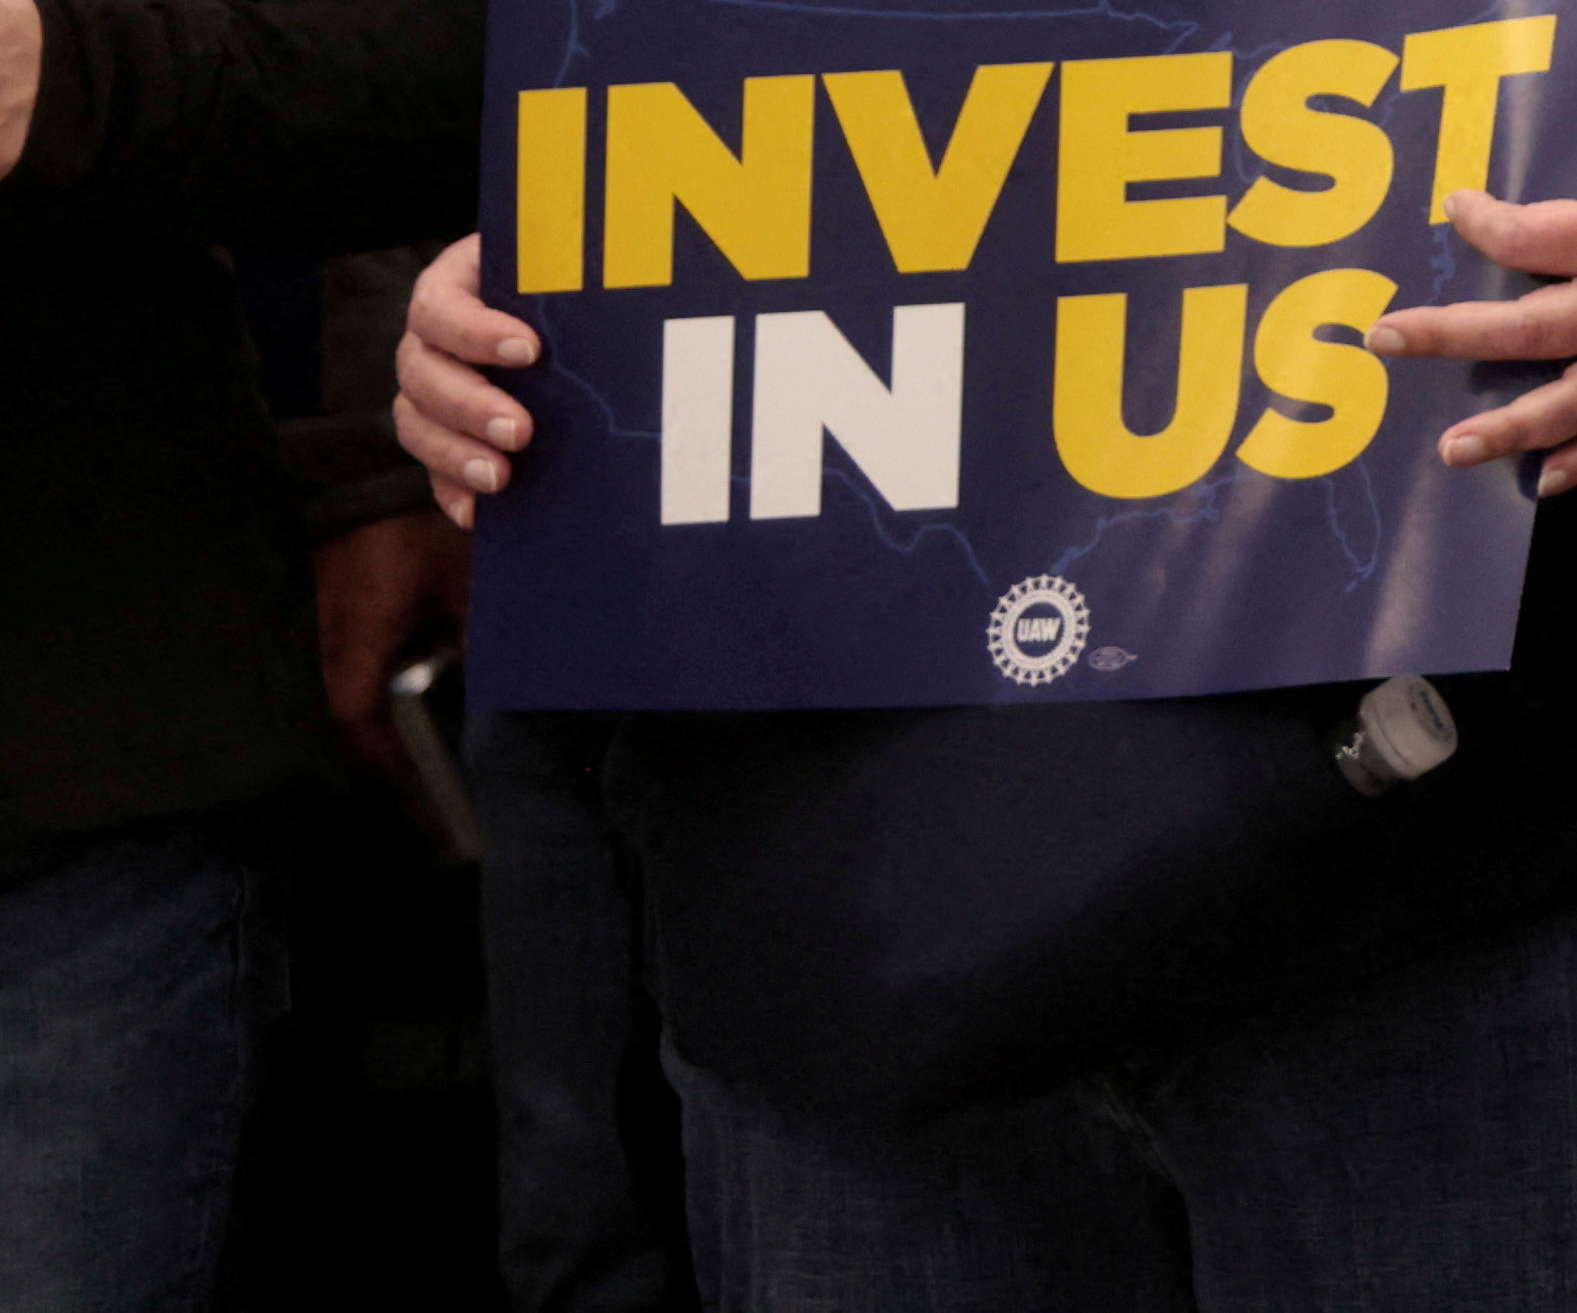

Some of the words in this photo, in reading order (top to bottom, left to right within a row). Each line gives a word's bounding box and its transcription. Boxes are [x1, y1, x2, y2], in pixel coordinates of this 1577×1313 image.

[516, 15, 1558, 294] INVEST
[660, 302, 966, 527] IN
[1051, 269, 1400, 501] US
[1016, 617, 1062, 643] UAW
